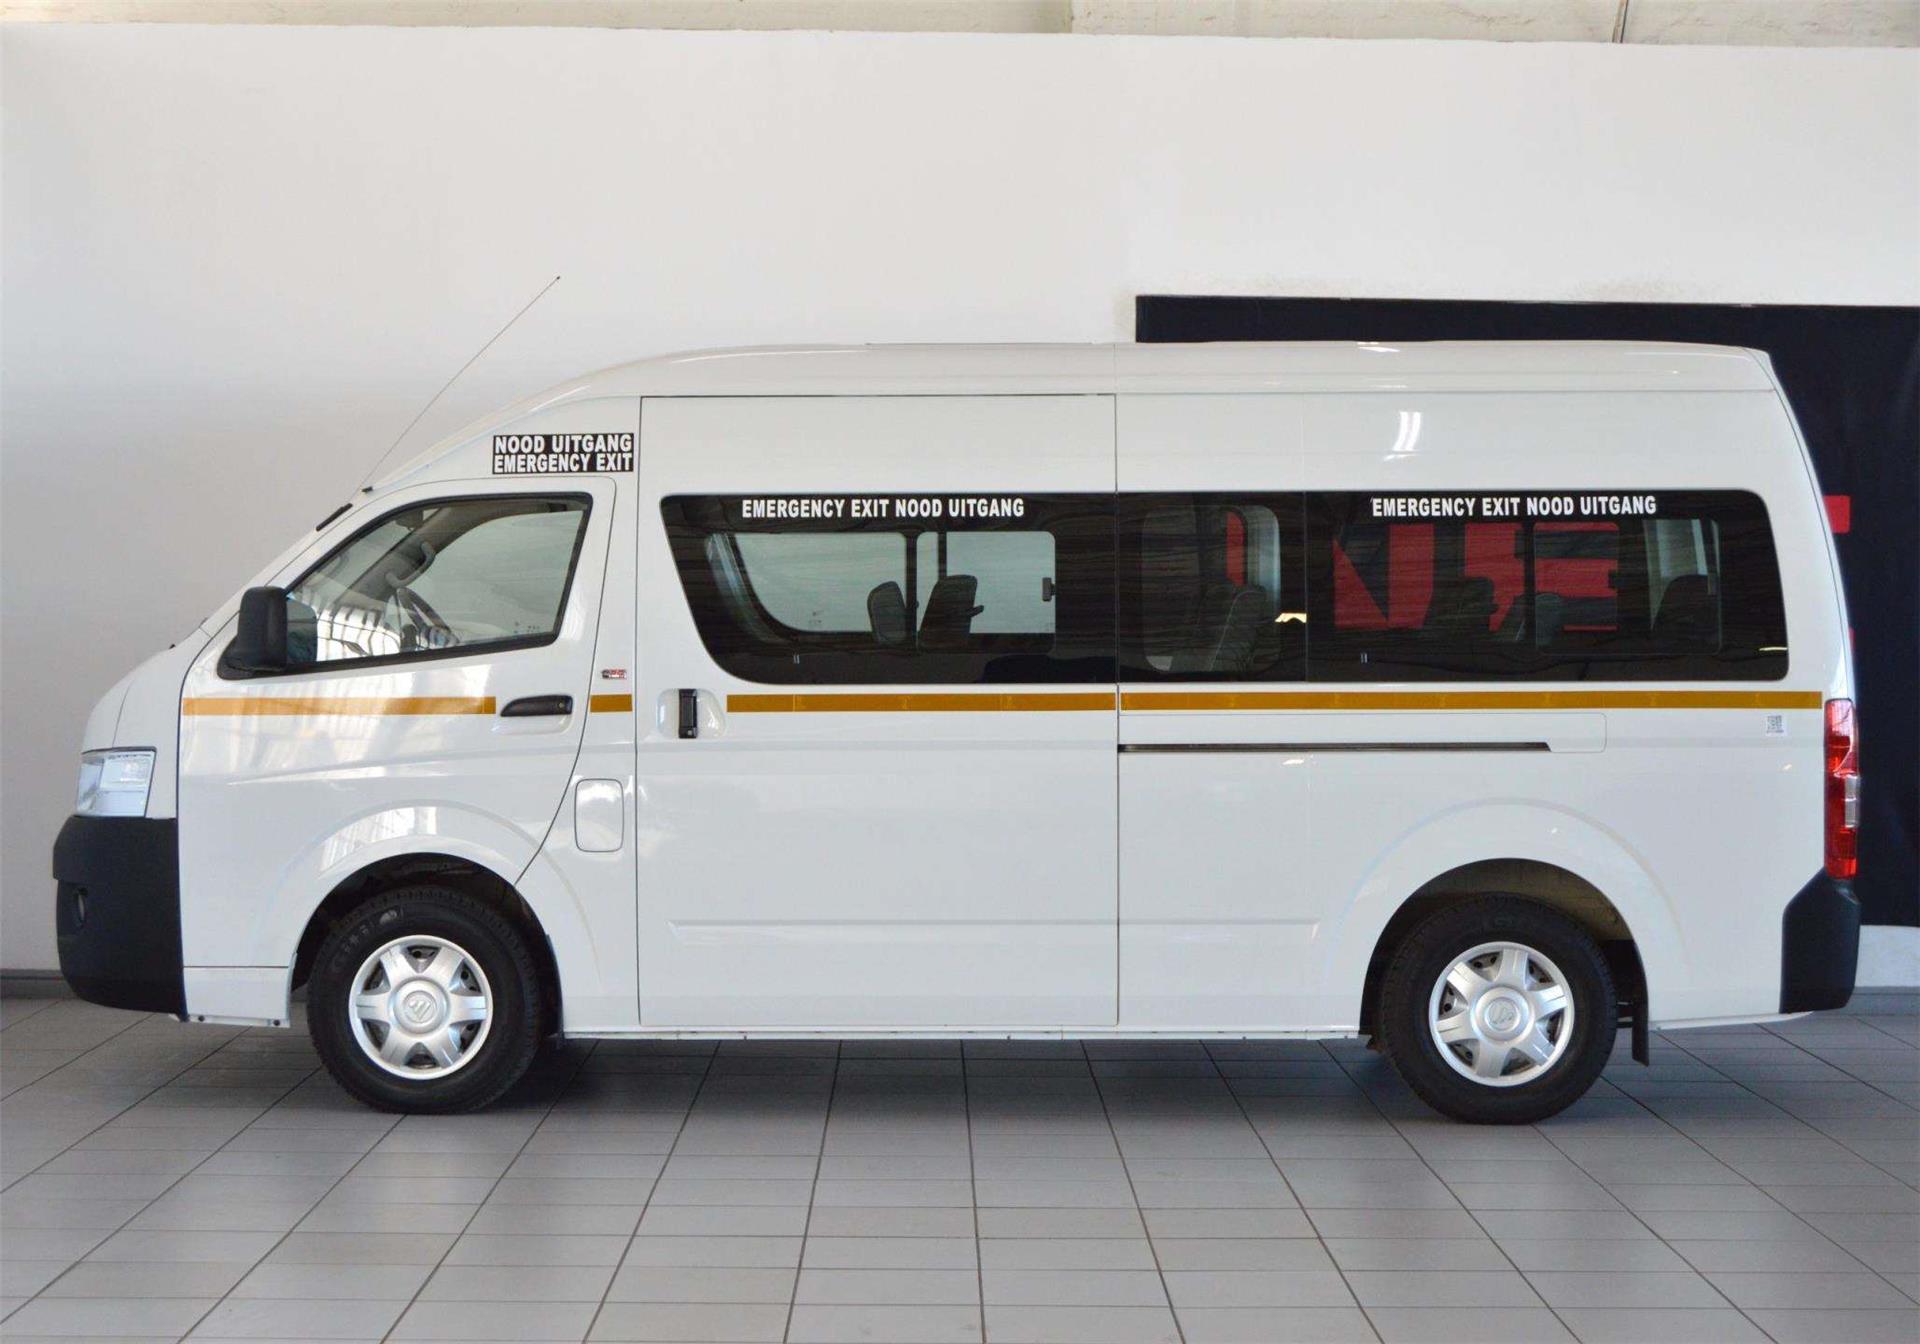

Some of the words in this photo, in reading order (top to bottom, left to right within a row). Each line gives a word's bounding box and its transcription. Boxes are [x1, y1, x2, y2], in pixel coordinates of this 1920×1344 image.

[495, 435, 545, 453] NOOD
[552, 433, 632, 453] UITGANG
[494, 453, 590, 473] EMERGENCY
[596, 452, 632, 471] EXIT
[743, 499, 845, 518] EMERGENCY
[851, 499, 889, 517] EXIT
[895, 499, 943, 517] NOOD
[949, 498, 1024, 517] UITGANG
[1372, 498, 1475, 516] EMERGENCY
[1482, 497, 1520, 516] EXIT
[1527, 497, 1573, 515] NOOD
[1581, 496, 1657, 514] UITGANG
